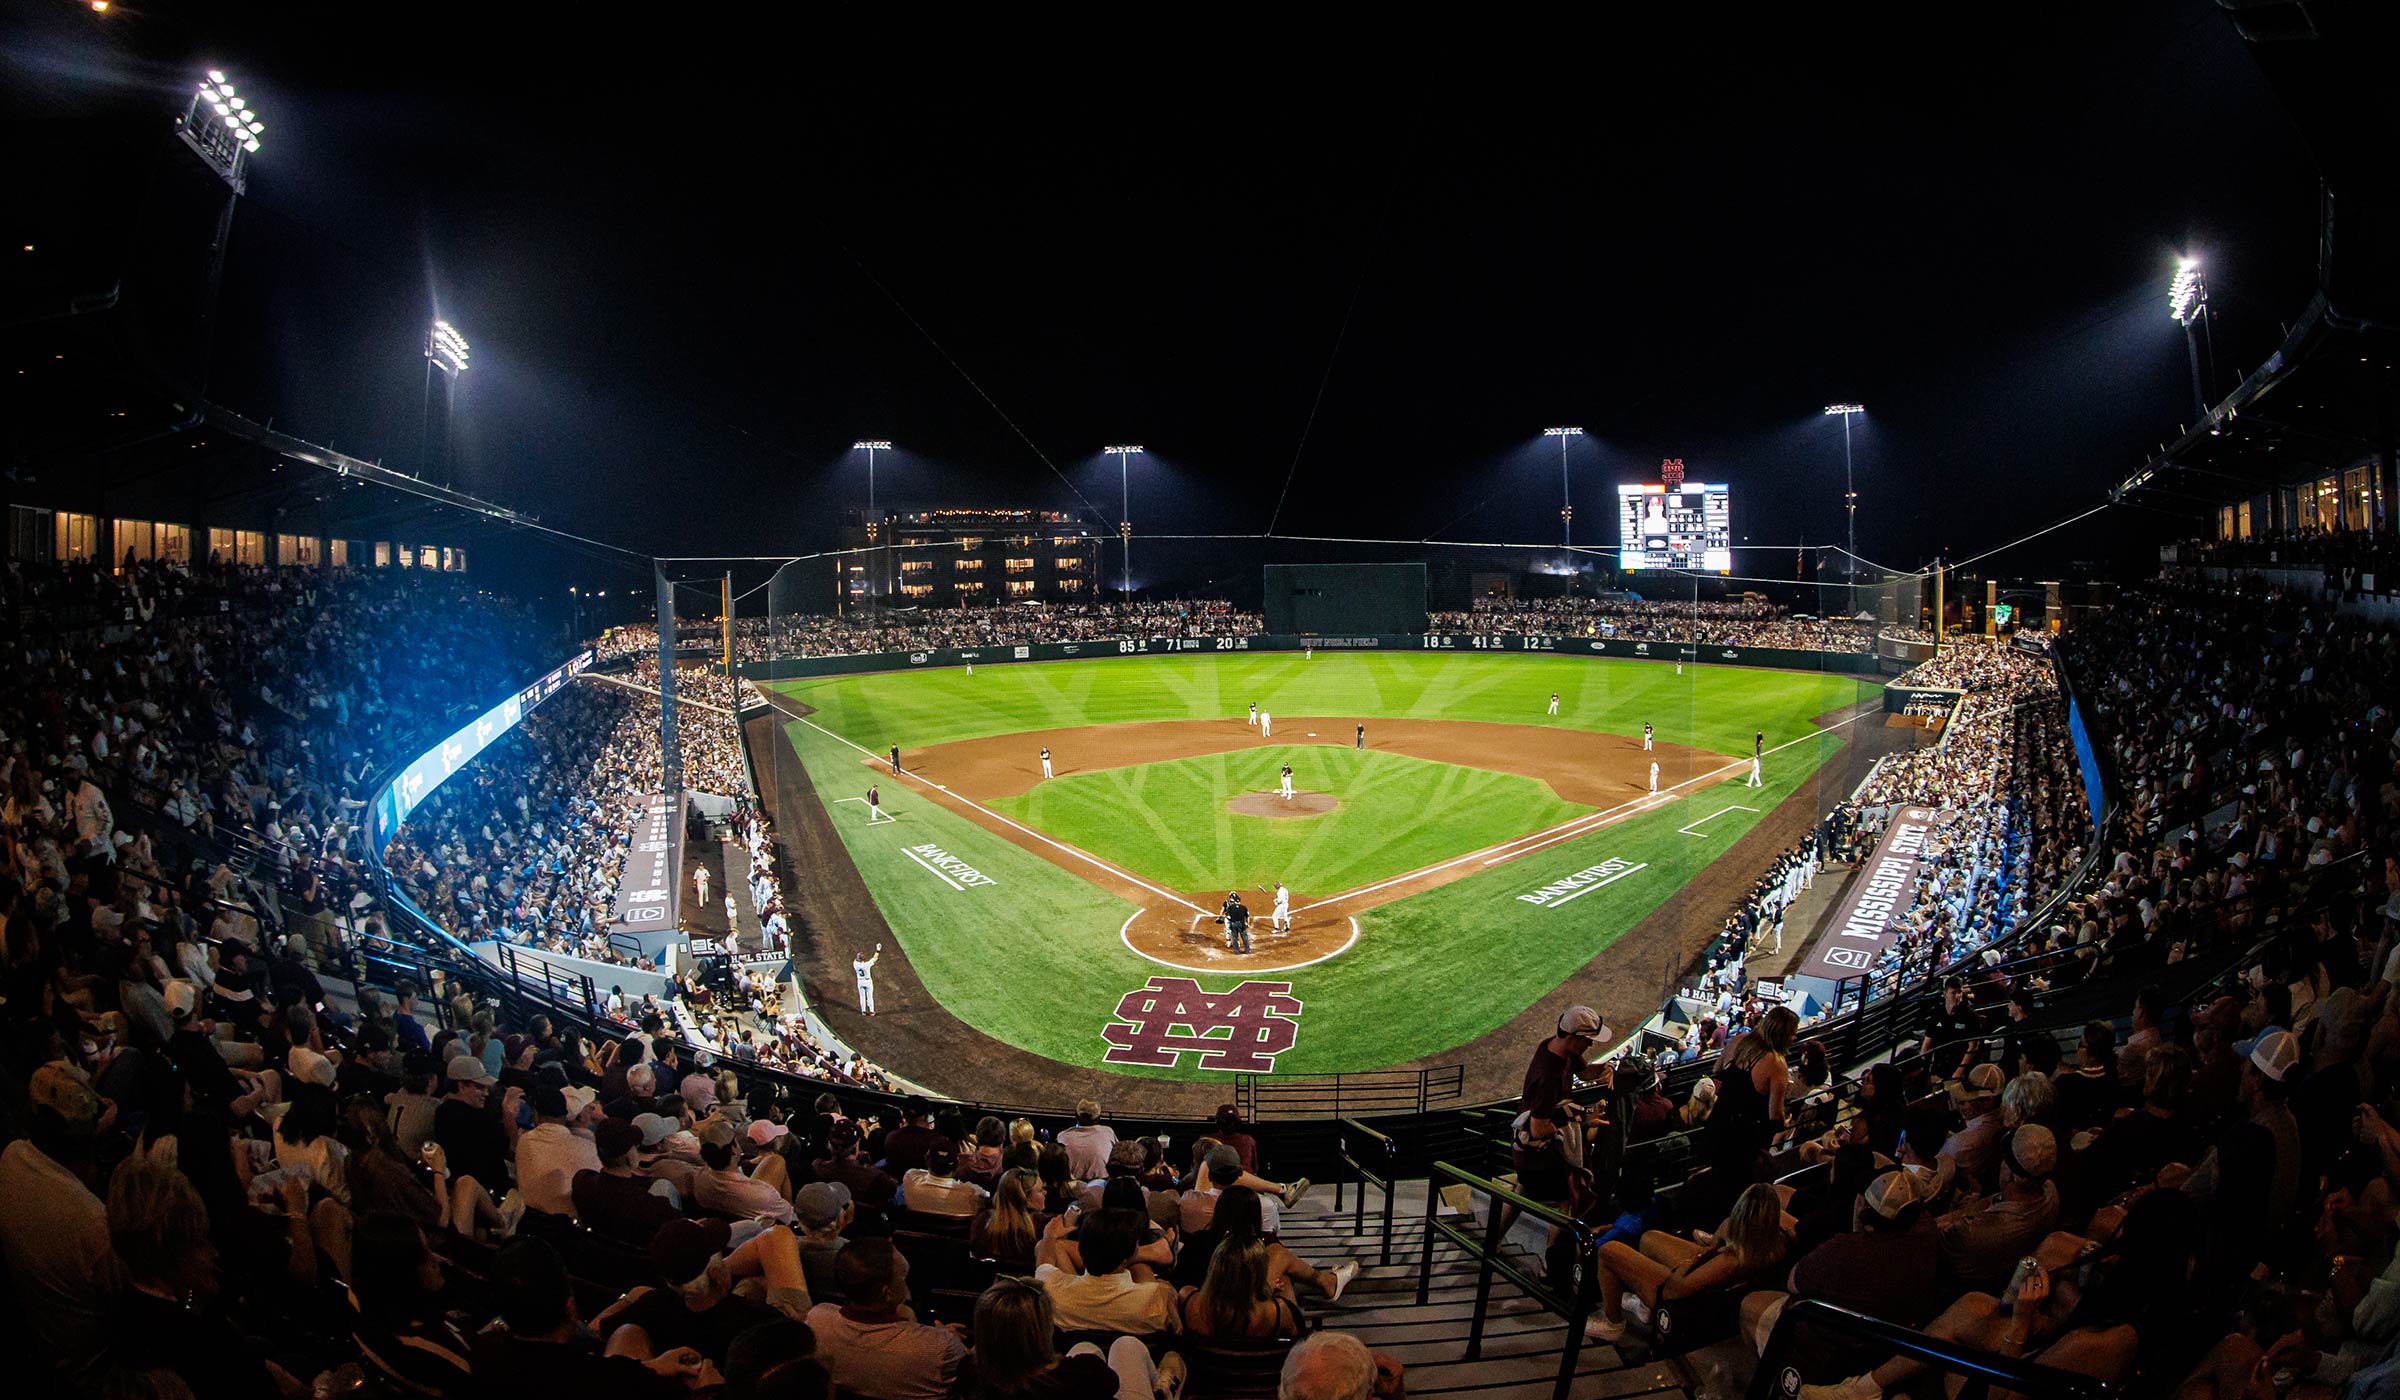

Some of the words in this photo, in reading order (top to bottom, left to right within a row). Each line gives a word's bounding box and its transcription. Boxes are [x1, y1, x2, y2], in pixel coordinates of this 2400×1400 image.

[1119, 640, 1135, 653] 85
[1166, 638, 1182, 651] 71
[1216, 637, 1233, 650] 20
[1353, 637, 1379, 647] FIELD
[1423, 636, 1439, 648] 18
[1472, 636, 1488, 648] 41
[1523, 637, 1539, 649] 12
[911, 843, 998, 888] BANKFIRST
[1515, 856, 1634, 905] BANKFIRST
[1840, 856, 1914, 941] MISSISSIPPI
[1887, 823, 1928, 855] STATE
[755, 951, 785, 962] STATE
[1692, 989, 1717, 1003] HAIL
